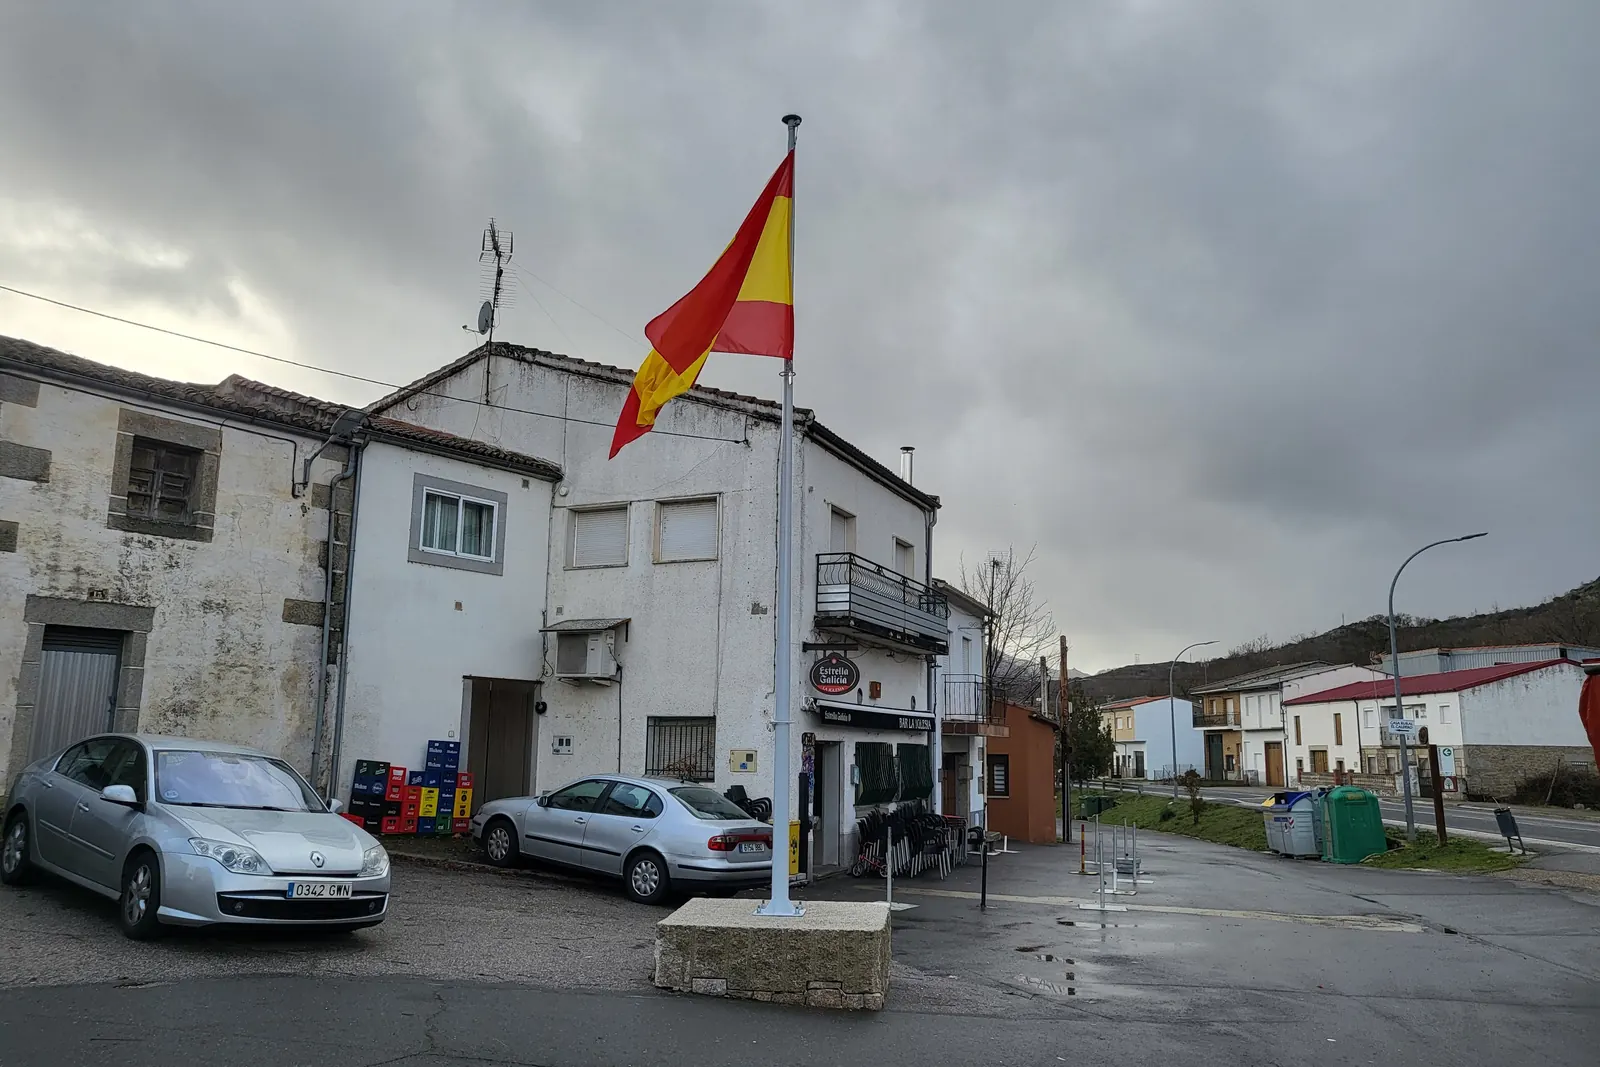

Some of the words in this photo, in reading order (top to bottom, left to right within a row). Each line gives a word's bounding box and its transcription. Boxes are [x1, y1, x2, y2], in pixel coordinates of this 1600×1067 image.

[818, 666, 849, 675] Estrella
[819, 674, 847, 684] Galicia
[899, 717, 909, 728] BAR
[909, 718, 915, 729] LA
[915, 719, 932, 730] IGLESIA
[296, 884, 326, 897] 0342
[328, 884, 350, 897] GWN
